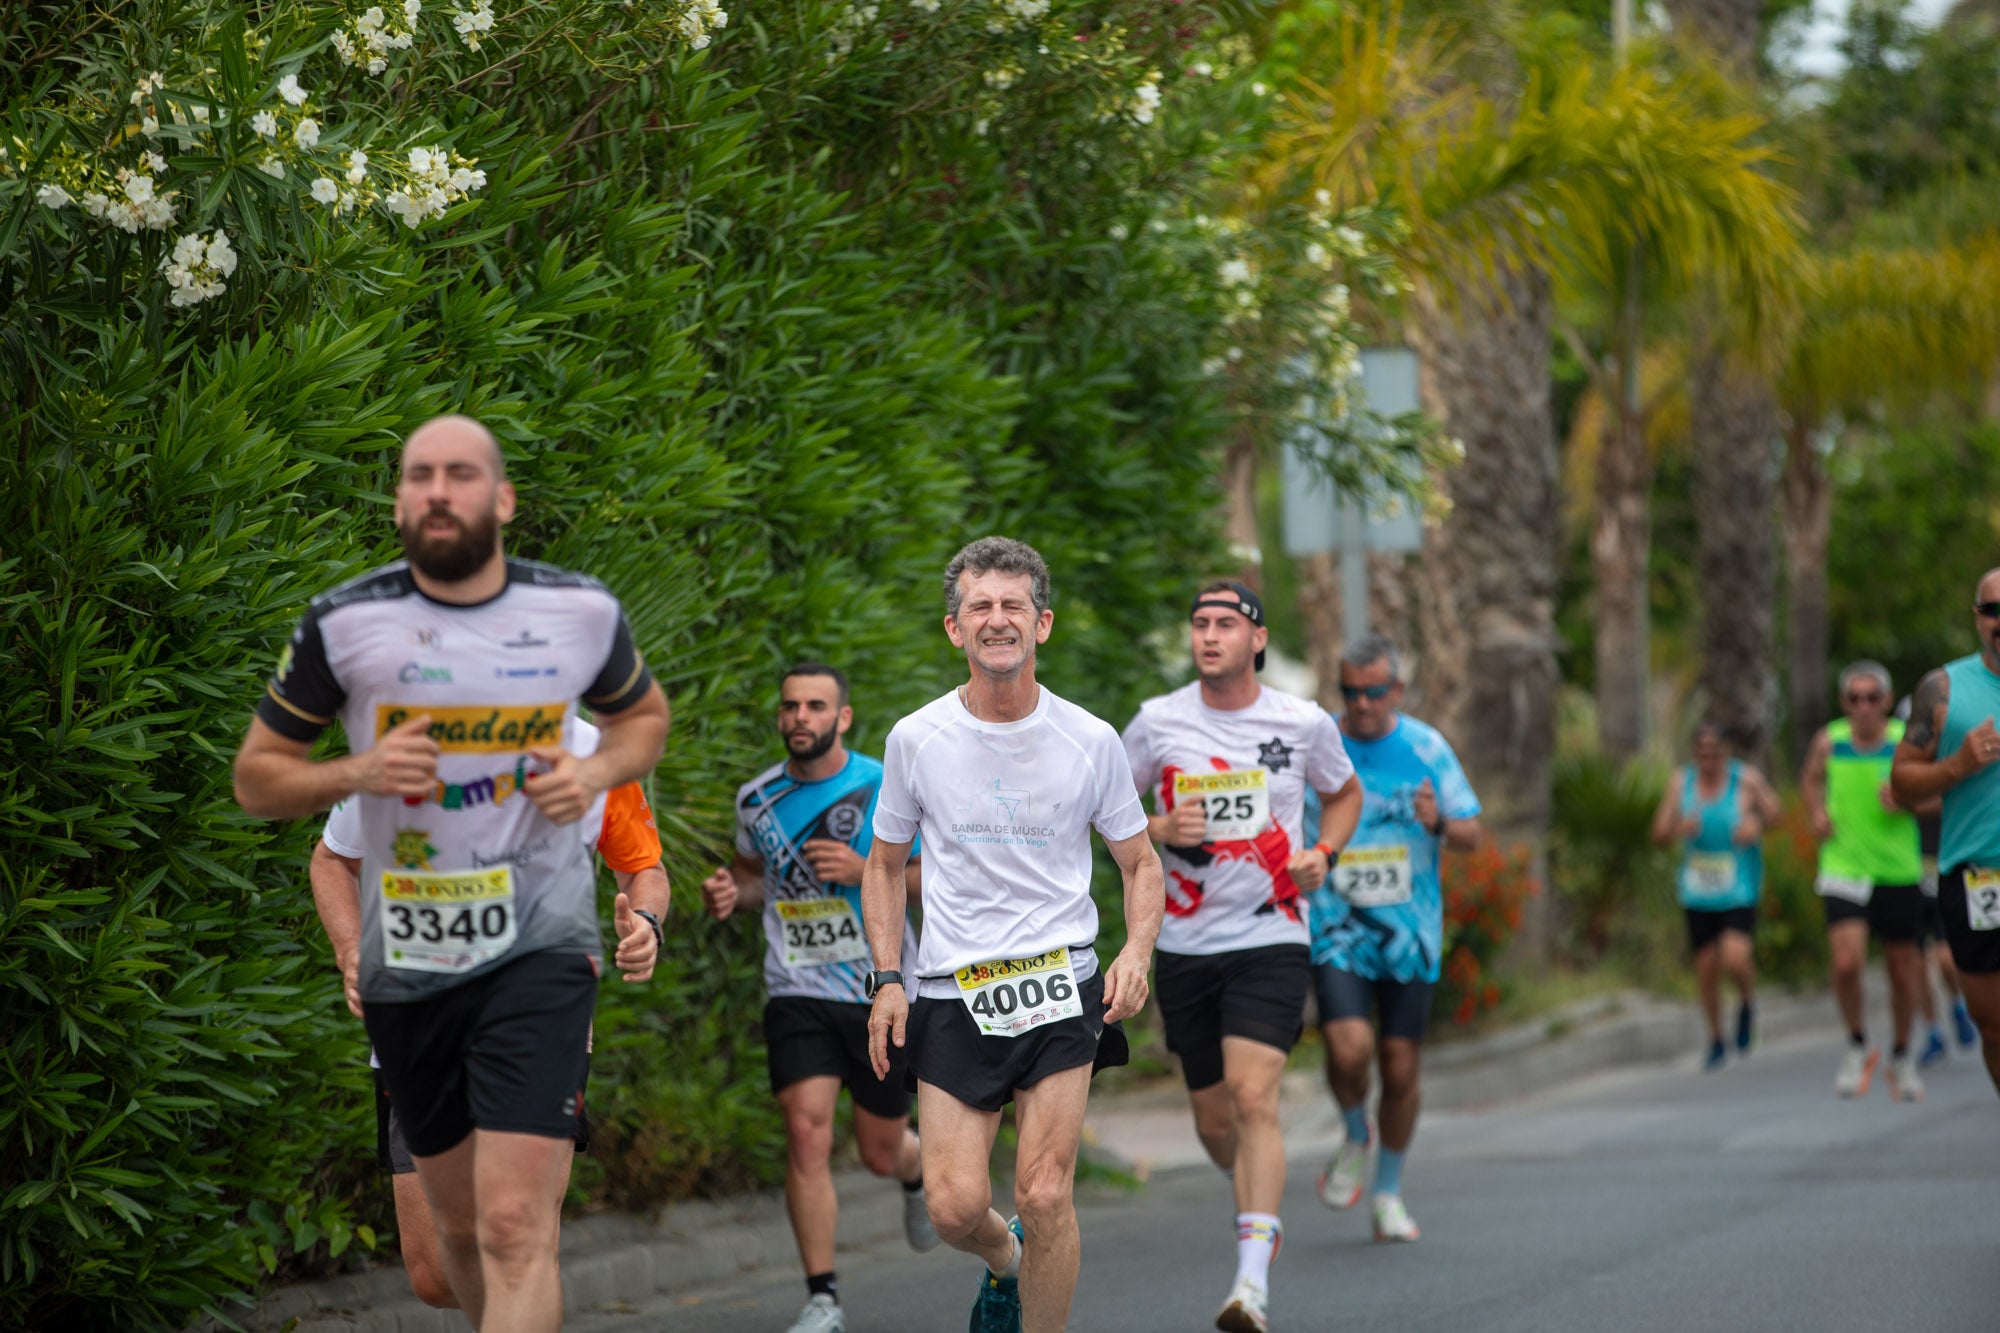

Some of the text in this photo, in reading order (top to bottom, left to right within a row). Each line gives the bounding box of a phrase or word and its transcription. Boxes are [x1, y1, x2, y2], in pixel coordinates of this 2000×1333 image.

[1201, 795, 1254, 823] 25
[951, 823, 1056, 837] BANDA DE MÚSICA
[957, 834, 1048, 848] Churriana de la Vega
[388, 904, 507, 944] 3340
[786, 917, 858, 948] 3234
[989, 957, 1046, 979] FONDO
[971, 973, 1074, 1019] 4006
